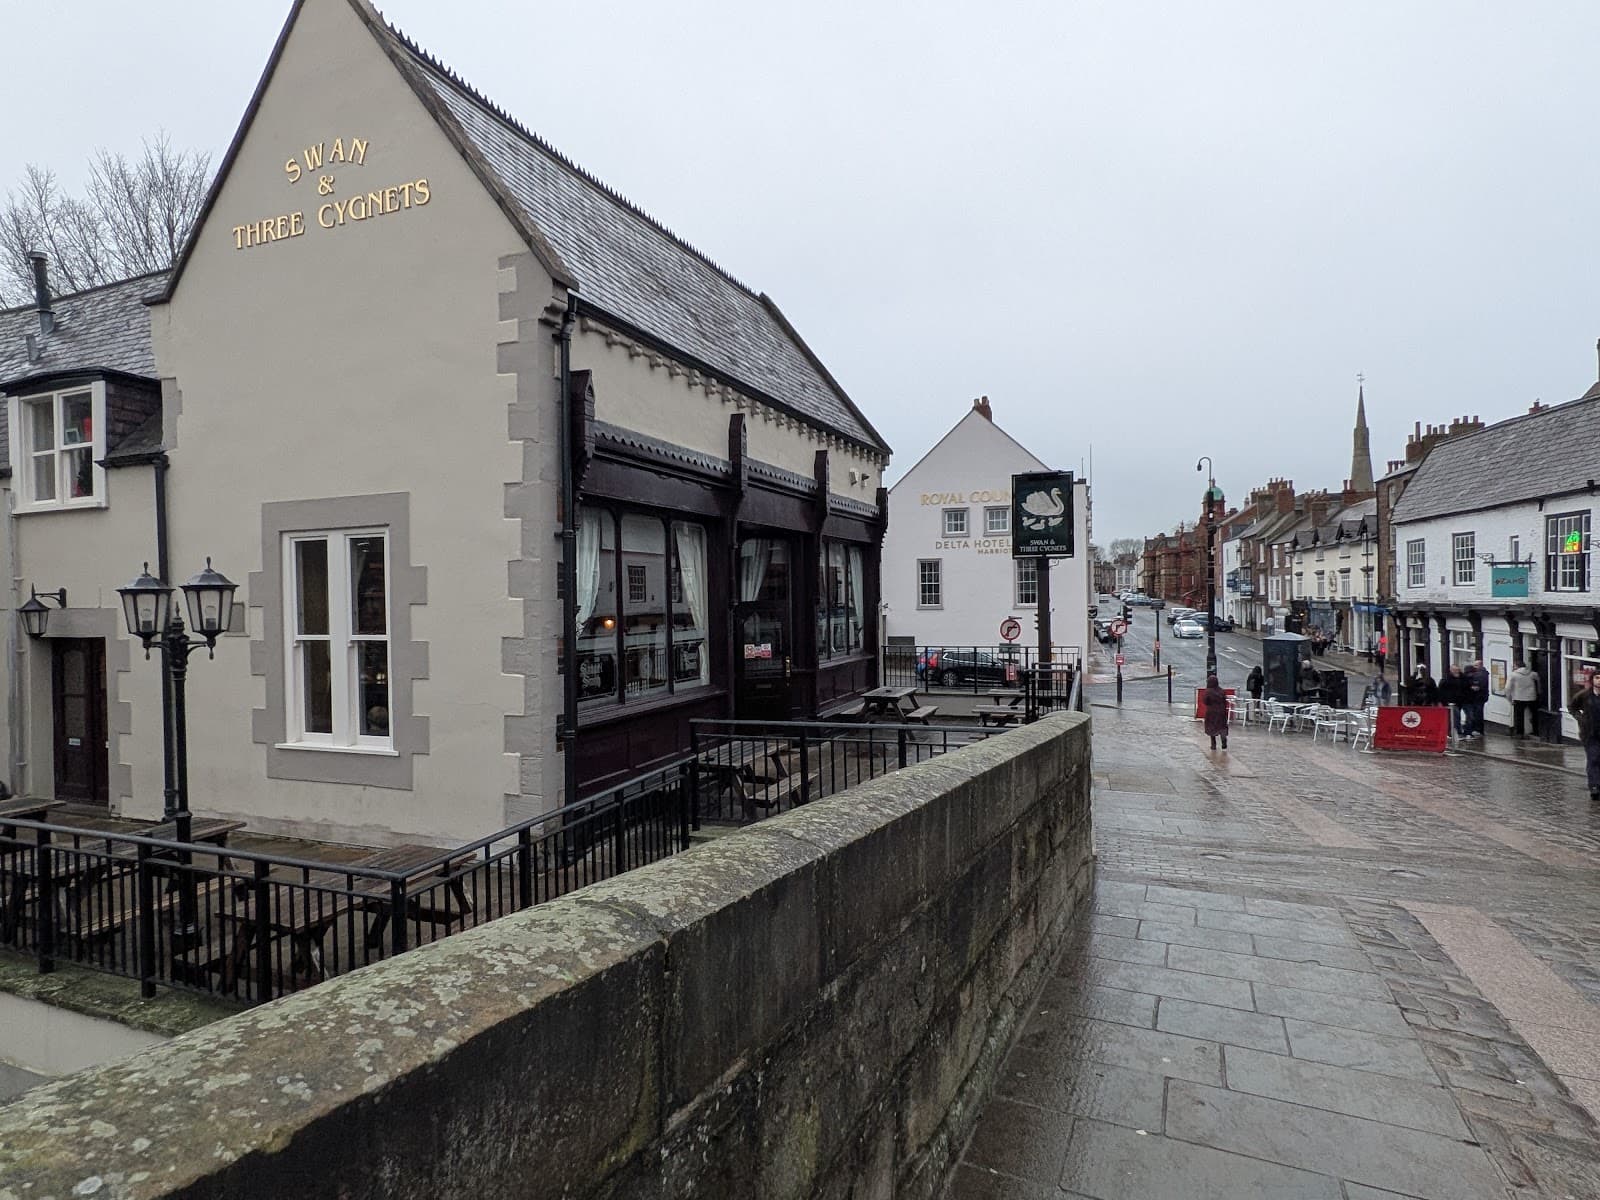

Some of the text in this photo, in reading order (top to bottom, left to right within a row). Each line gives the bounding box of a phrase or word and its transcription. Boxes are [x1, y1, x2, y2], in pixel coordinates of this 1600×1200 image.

[285, 138, 369, 183] SWAN
[318, 175, 335, 196] &
[233, 179, 430, 249] THREE CYGNETS
[920, 492, 966, 505] ROYAL
[935, 539, 1011, 550] DELTA HOTEL
[1020, 544, 1067, 553] THREE CYGNETS
